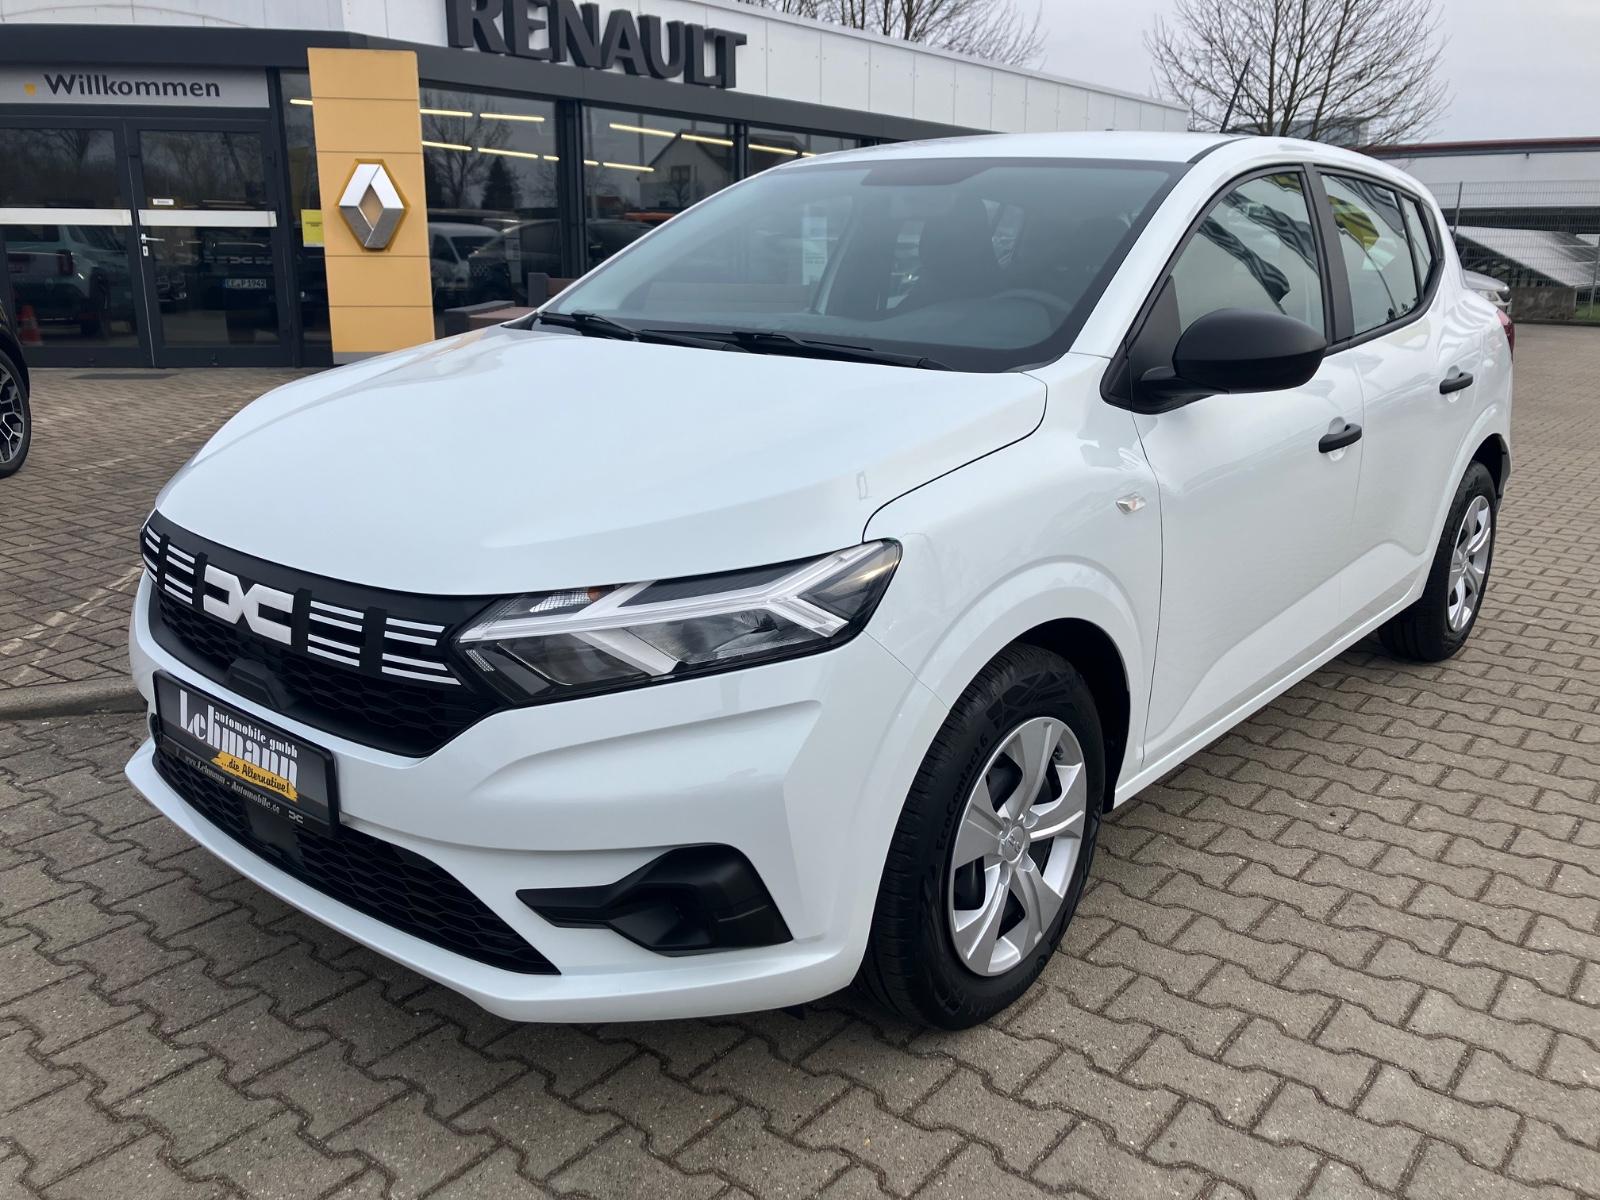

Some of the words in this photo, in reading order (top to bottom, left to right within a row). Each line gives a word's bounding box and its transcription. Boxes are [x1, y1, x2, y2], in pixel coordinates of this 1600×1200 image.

[446, 0, 747, 90] RENAULT
[44, 73, 221, 98] Willkommen
[179, 689, 298, 788] Lehmann
[214, 711, 267, 744] automobile
[269, 739, 298, 758] gmbh
[241, 764, 290, 794] Alternative!
